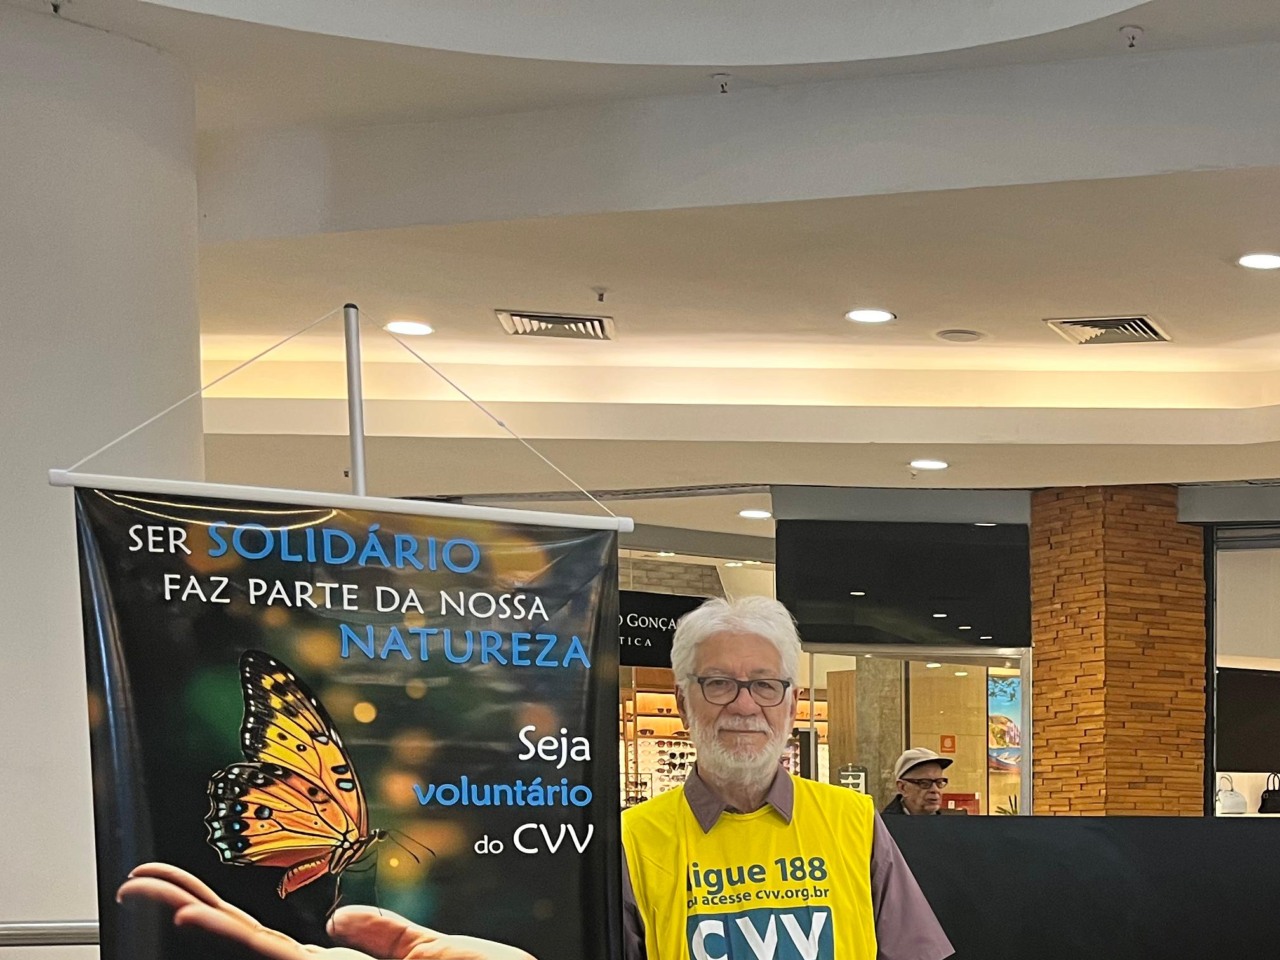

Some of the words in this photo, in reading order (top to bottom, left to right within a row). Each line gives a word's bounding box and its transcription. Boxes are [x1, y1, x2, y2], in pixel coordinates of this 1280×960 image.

[128, 525, 191, 555] SER
[208, 521, 480, 573] SOLIDÁRIO
[163, 574, 230, 603] FAZ
[248, 579, 359, 611] PARTE
[375, 586, 425, 614] DA
[440, 590, 549, 621] NOSSA
[339, 624, 591, 669] NATUREZA
[518, 725, 591, 768] Seja
[413, 776, 593, 807] voluntário
[474, 835, 503, 854] do
[513, 823, 594, 855] CVV
[775, 856, 827, 882] 188
[702, 891, 751, 906] acesse
[755, 886, 829, 901] cvv.org.br
